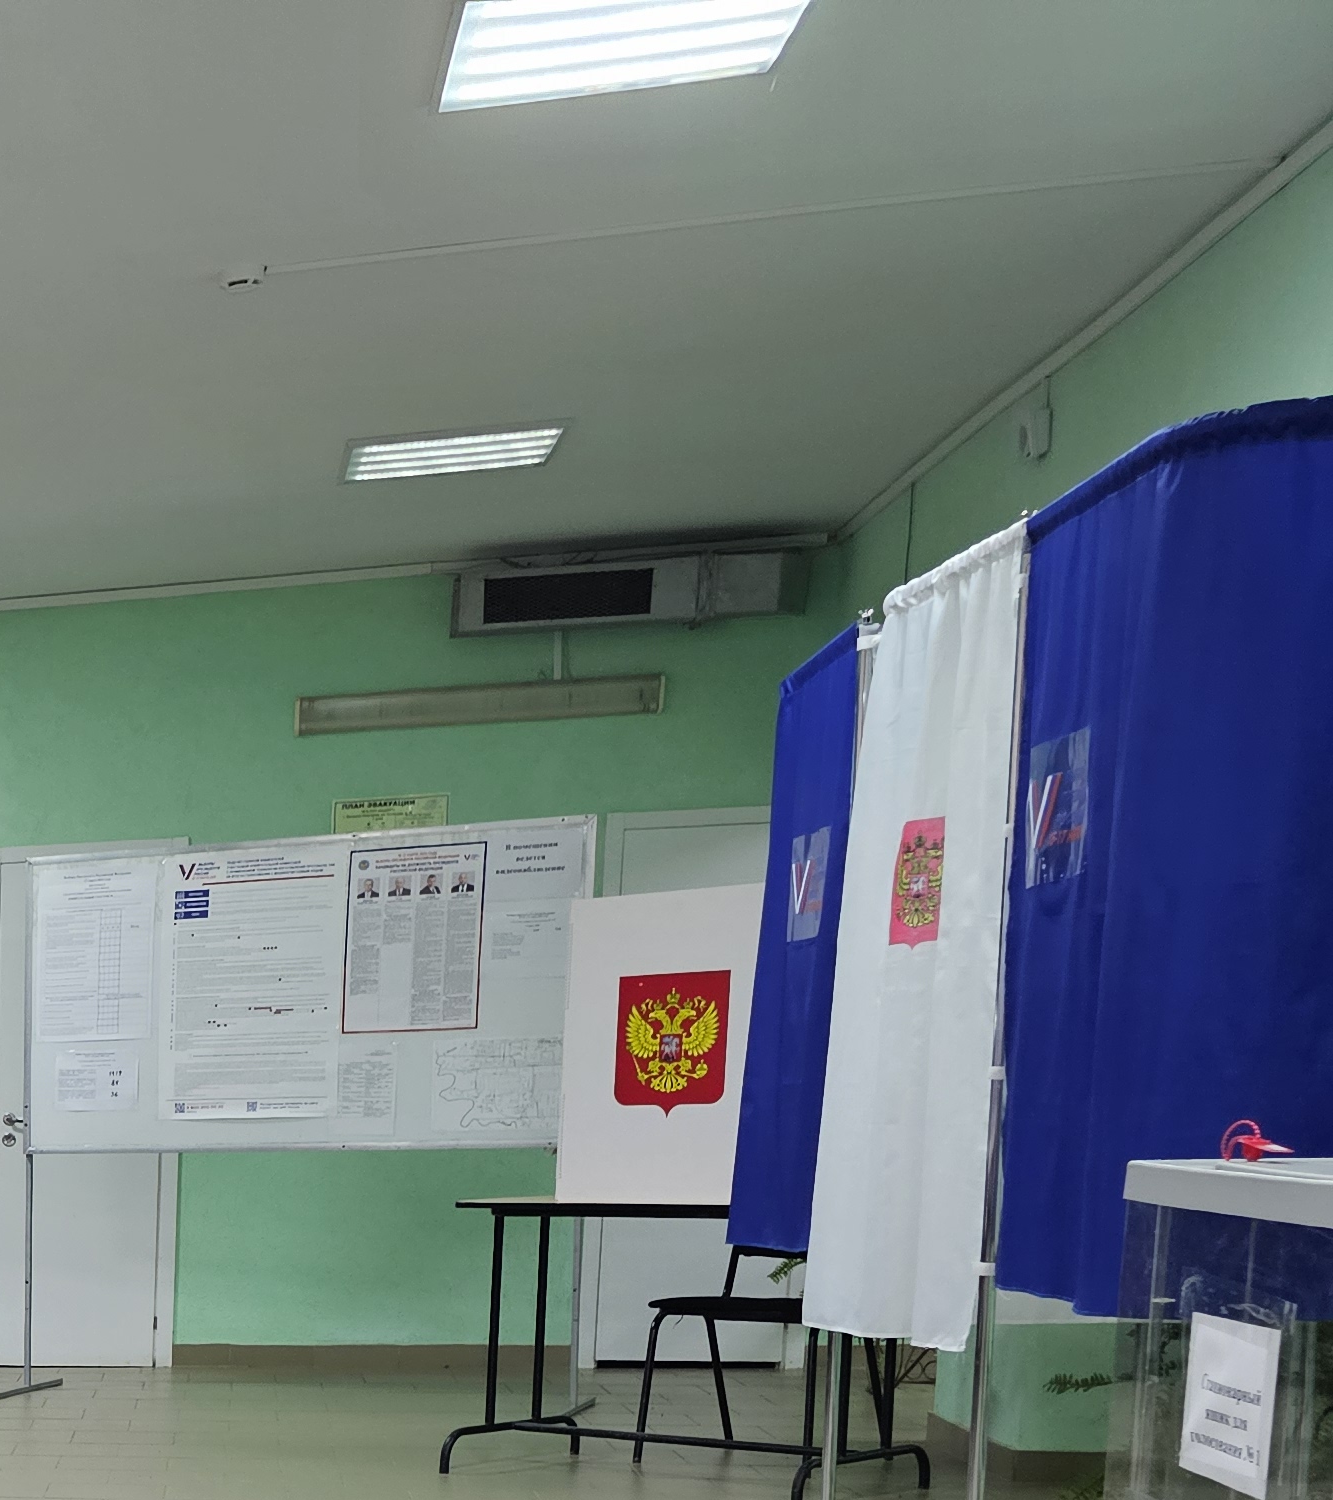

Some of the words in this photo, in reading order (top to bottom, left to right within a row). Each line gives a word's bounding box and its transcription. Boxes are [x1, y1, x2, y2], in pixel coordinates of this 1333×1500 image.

[341, 803, 365, 811] ПЛАН
[367, 799, 416, 809] ЭВАКУАЦИИ
[1201, 1373, 1262, 1407] Стационарный
[1190, 1432, 1243, 1460] голосования
